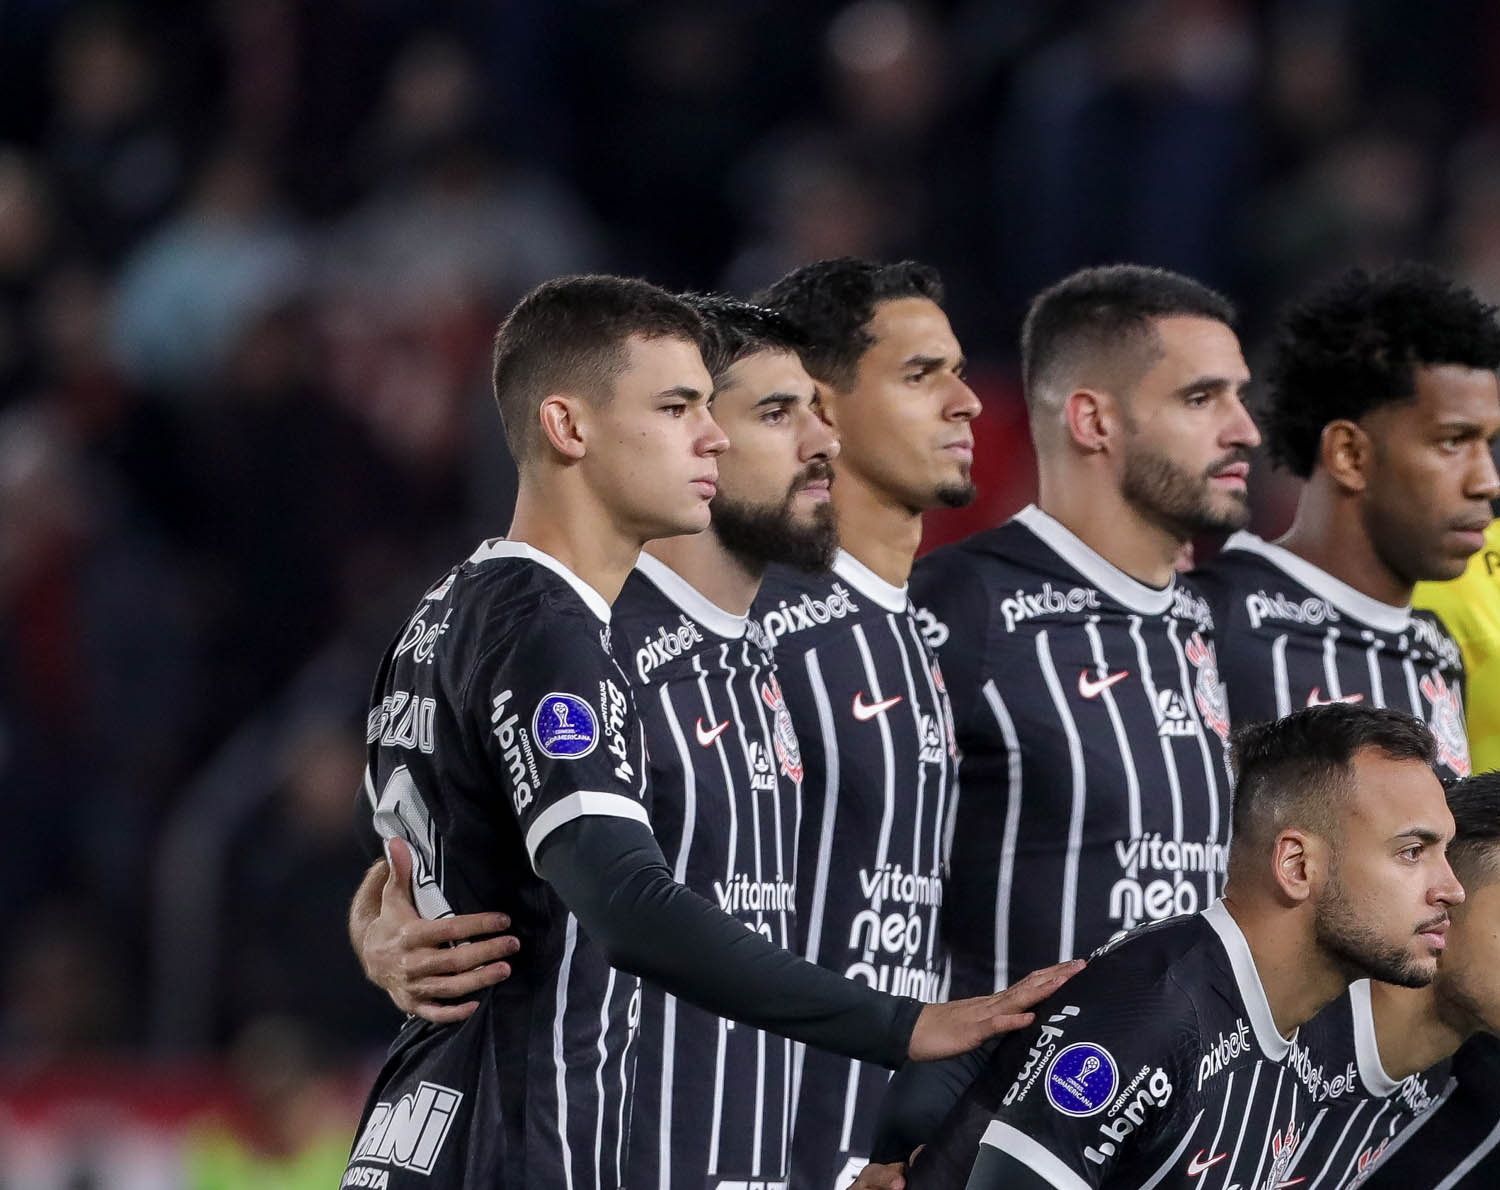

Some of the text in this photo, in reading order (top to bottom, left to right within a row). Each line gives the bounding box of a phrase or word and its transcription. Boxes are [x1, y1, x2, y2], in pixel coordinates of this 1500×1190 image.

[764, 582, 859, 647] pixbet
[1000, 582, 1101, 632] pixbet
[636, 614, 704, 685] pixbet
[518, 728, 541, 789] CORINTHIANS
[750, 773, 777, 790] ALE
[859, 863, 943, 908] vitamin
[1108, 878, 1200, 921] neo
[849, 909, 922, 953] neo
[1017, 1043, 1057, 1102] CORINTHIANS
[1197, 1018, 1251, 1092] pixbet
[1051, 1074, 1094, 1109] SUDAMERICANA
[1107, 1064, 1151, 1118] CORINTHIANS
